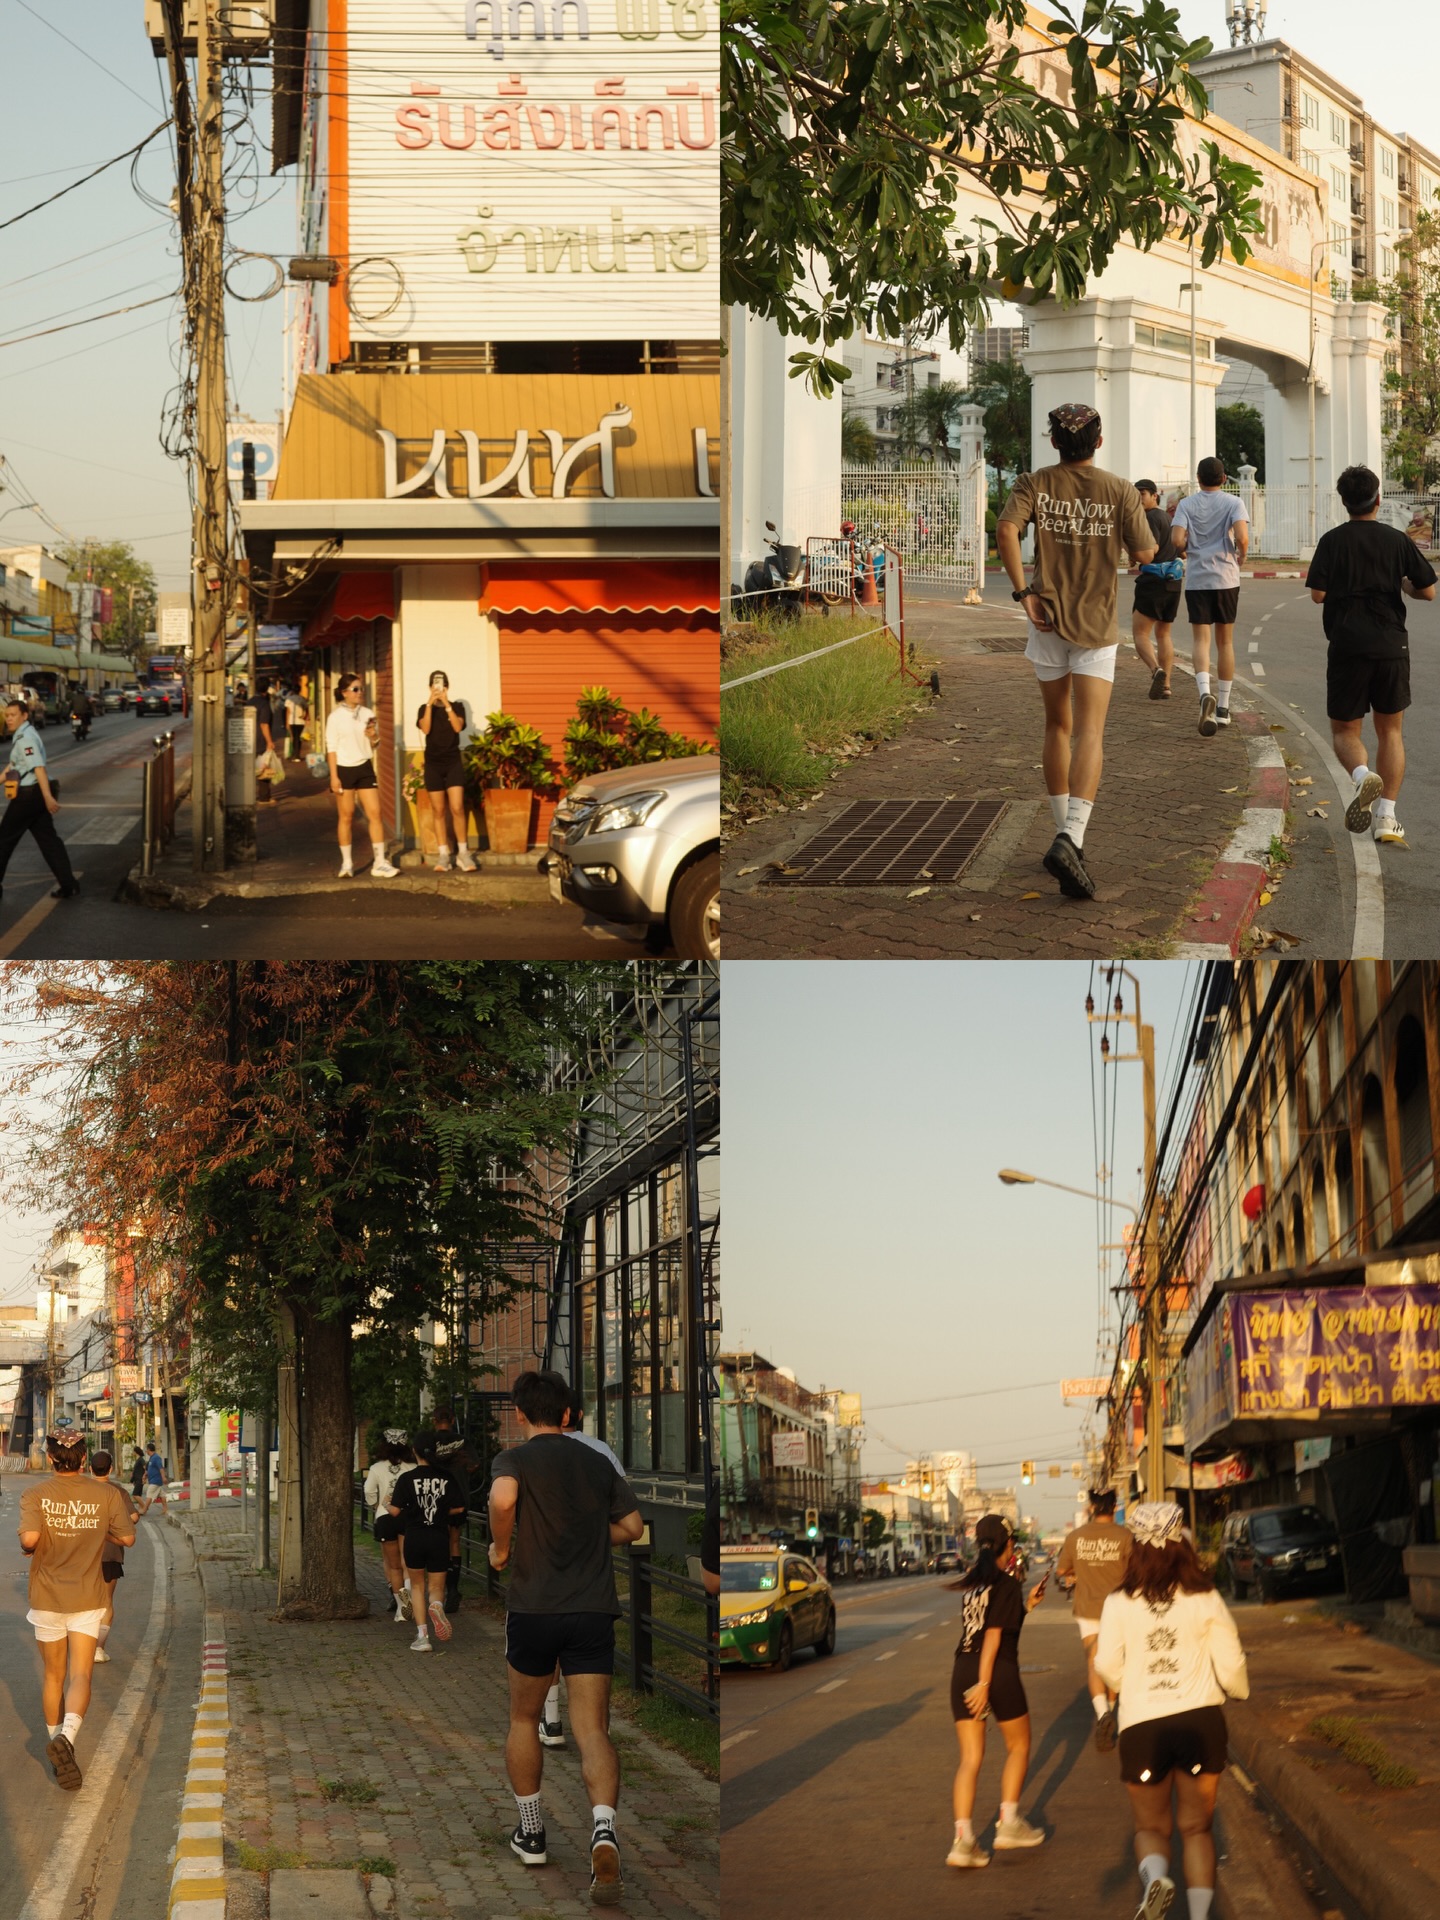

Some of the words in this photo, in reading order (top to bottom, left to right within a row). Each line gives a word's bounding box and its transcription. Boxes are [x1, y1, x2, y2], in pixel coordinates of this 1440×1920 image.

[456, 203, 709, 273] จำหน่าย
[413, 1477, 449, 1496] F#CK
